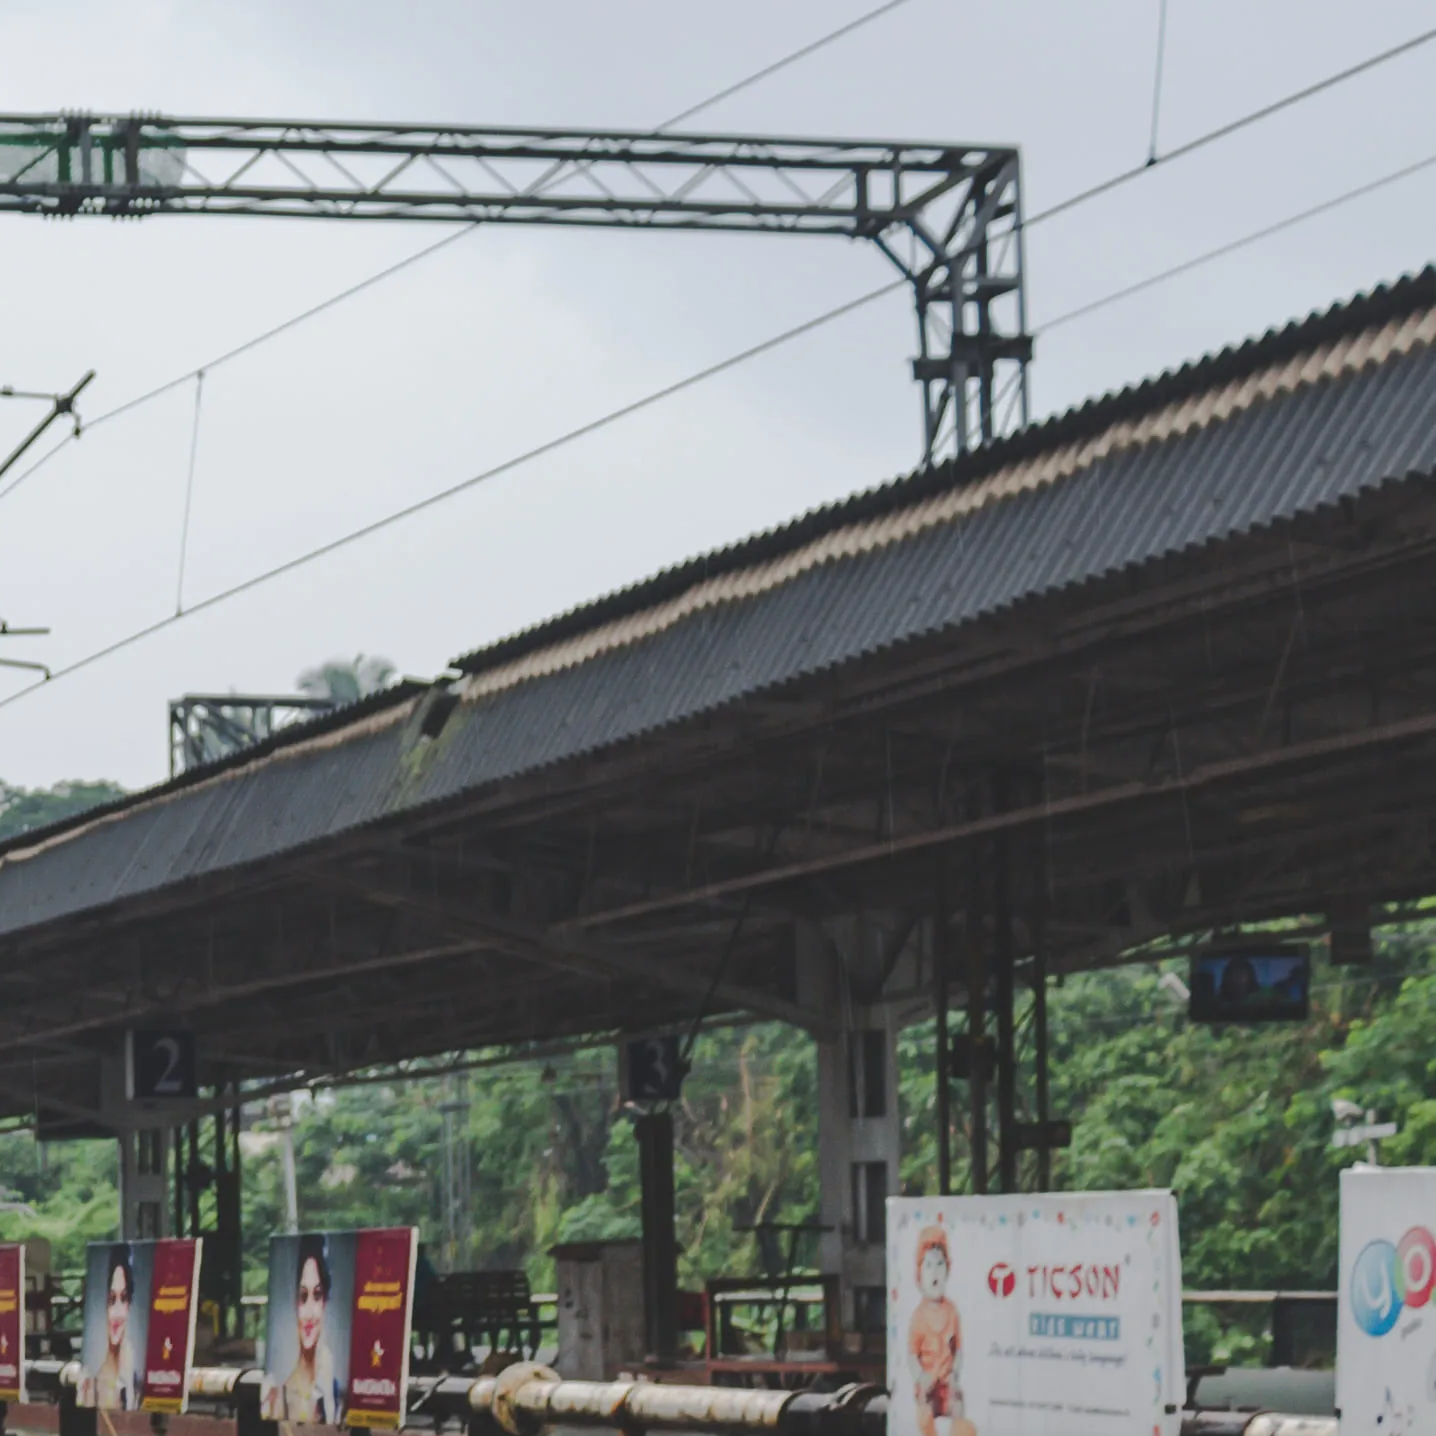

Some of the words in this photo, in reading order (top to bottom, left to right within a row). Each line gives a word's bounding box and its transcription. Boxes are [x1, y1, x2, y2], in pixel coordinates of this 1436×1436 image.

[152, 1036, 185, 1093] 2
[642, 1039, 670, 1095] 3
[1026, 1263, 1121, 1301] TICSON
